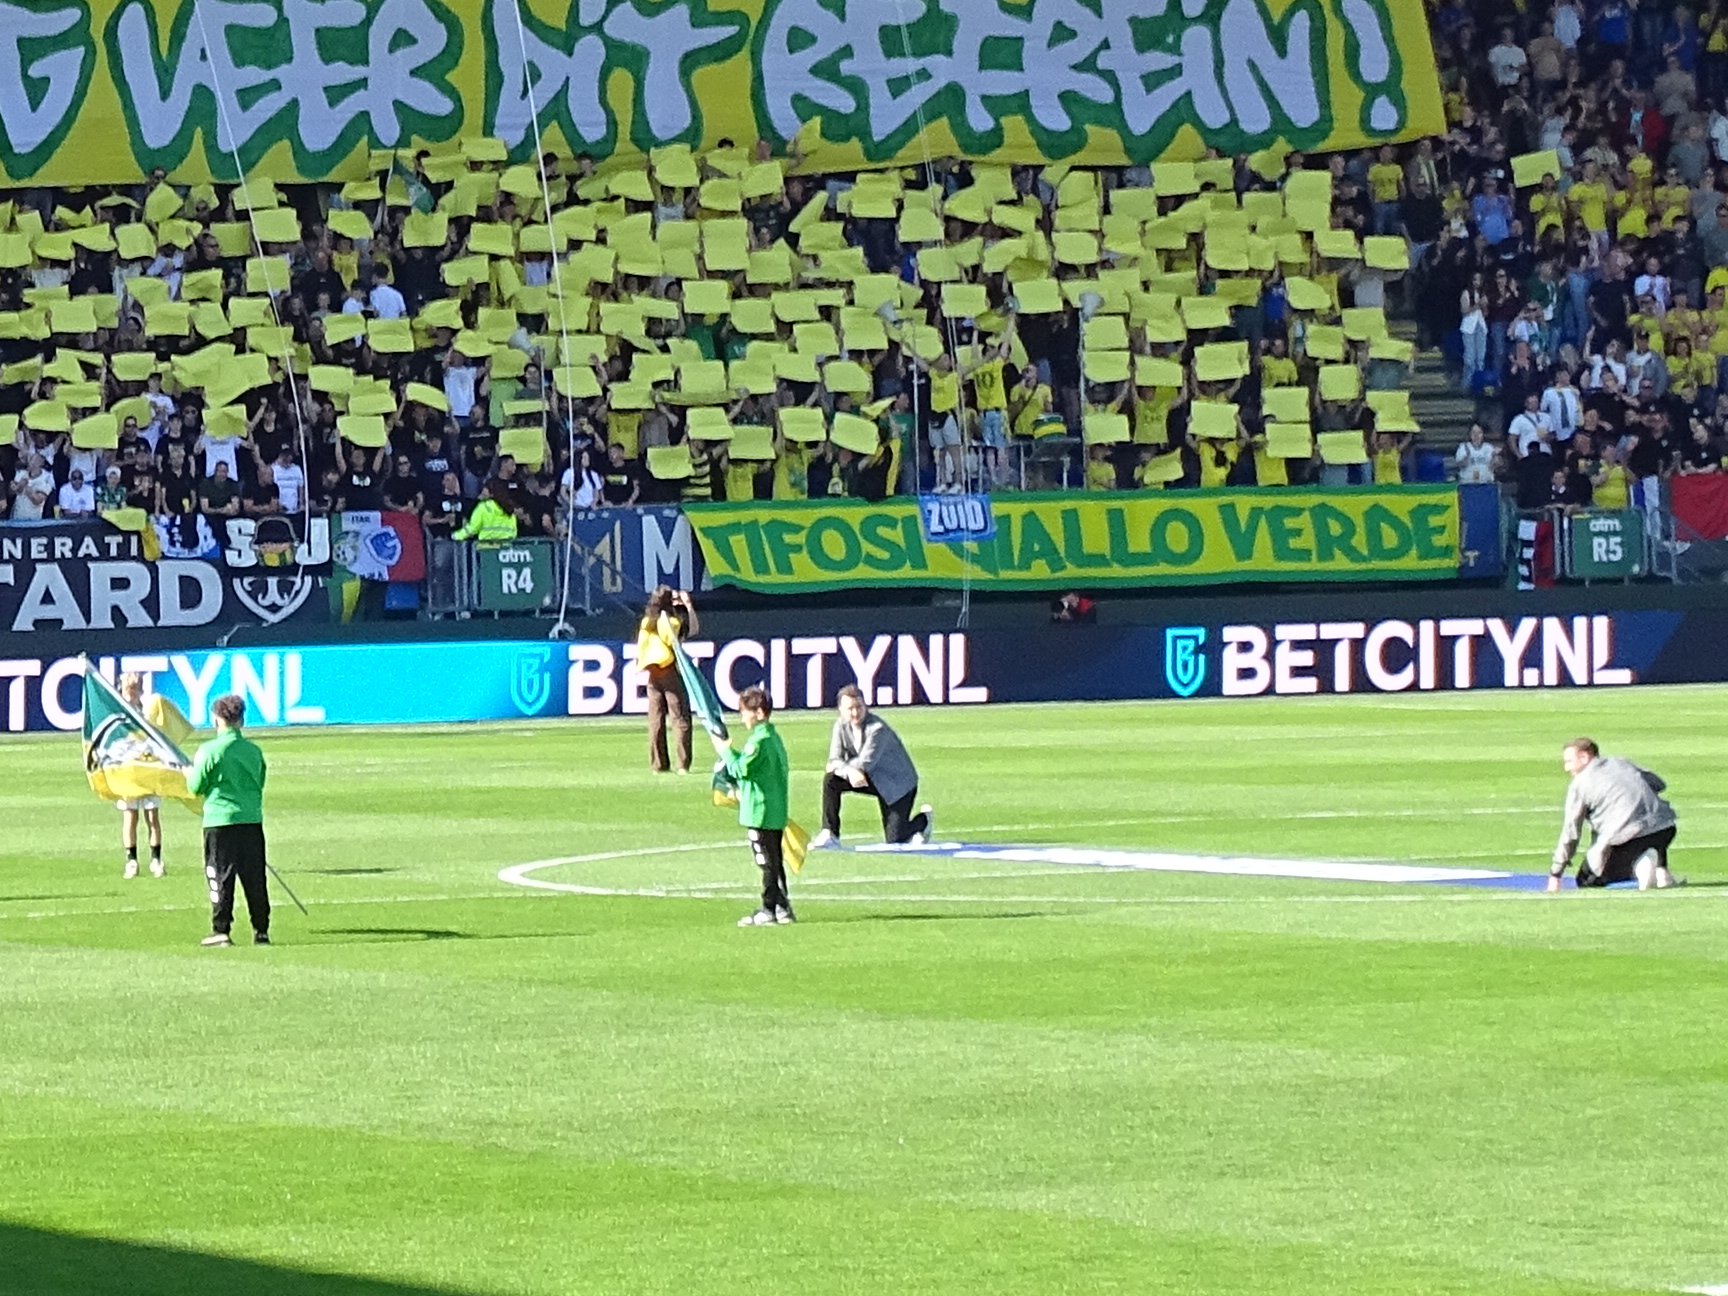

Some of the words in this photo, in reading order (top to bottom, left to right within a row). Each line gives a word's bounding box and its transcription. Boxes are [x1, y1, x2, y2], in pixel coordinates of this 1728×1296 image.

[927, 500, 986, 533] ZUID
[698, 513, 928, 576] TIFOSI
[1219, 502, 1451, 563] VERDE
[1593, 537, 1623, 562] R5
[502, 567, 534, 594] R4
[1222, 614, 1632, 697] BETCITY.NL
